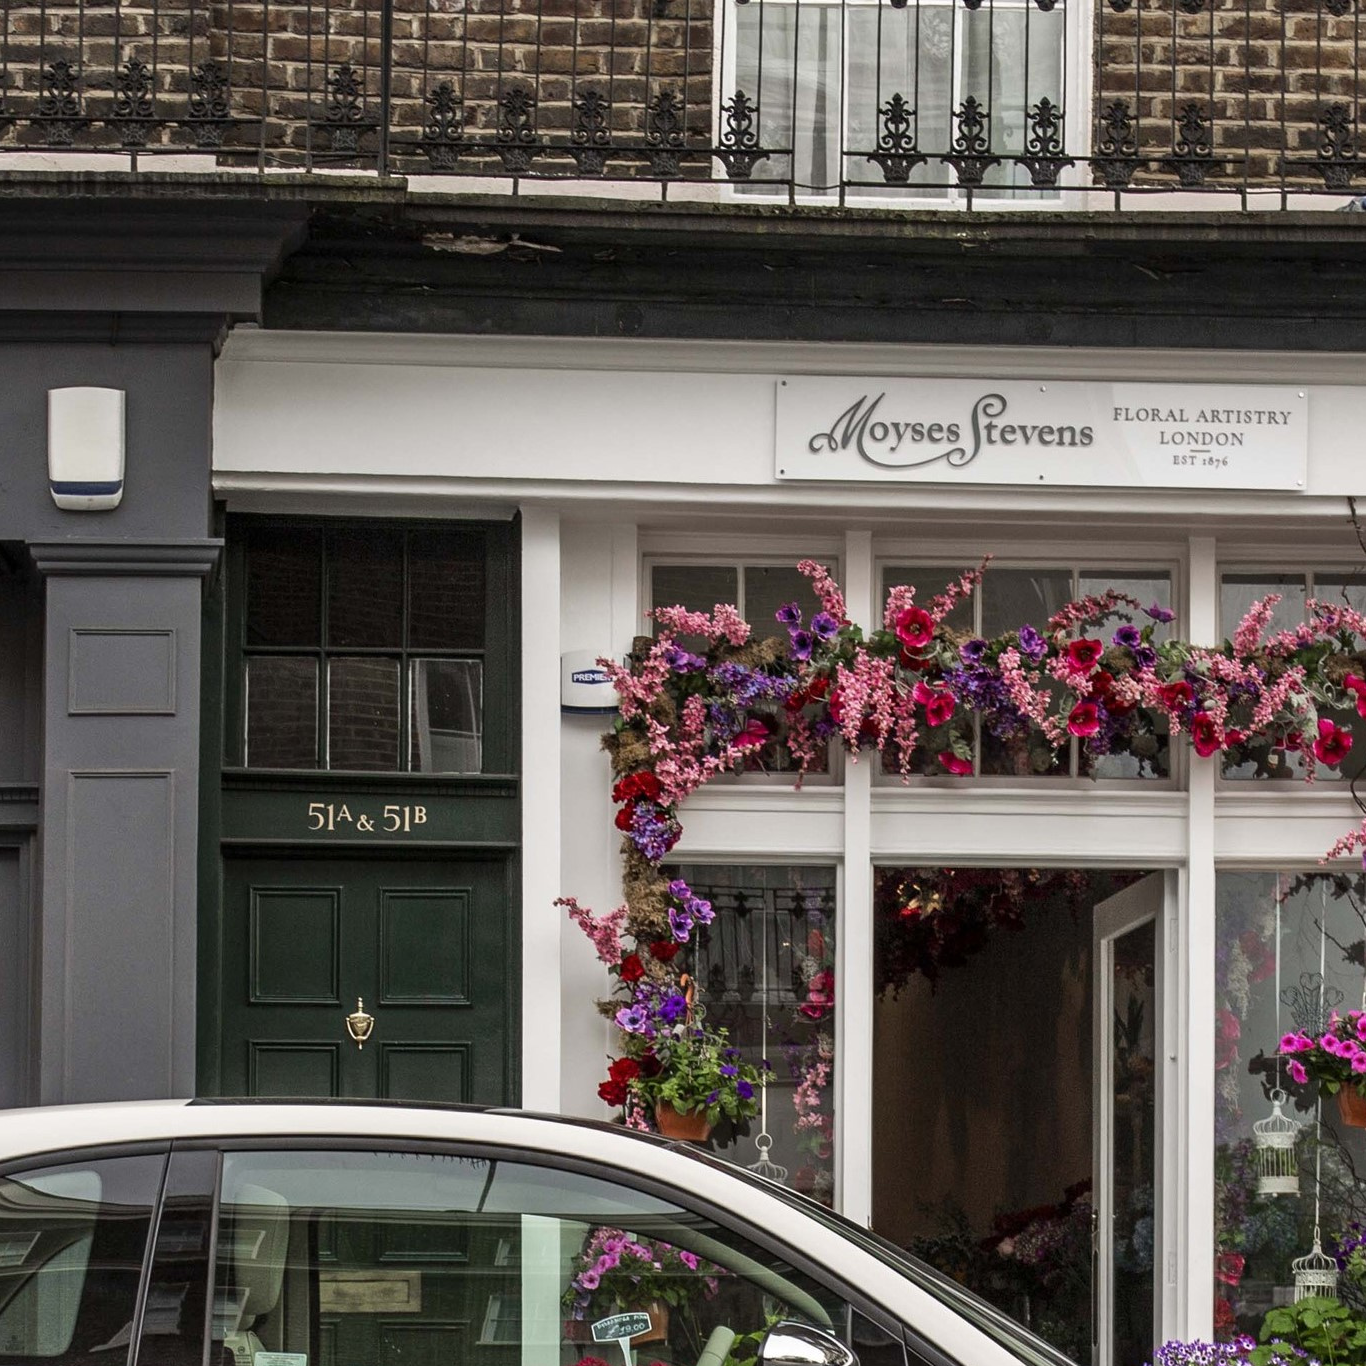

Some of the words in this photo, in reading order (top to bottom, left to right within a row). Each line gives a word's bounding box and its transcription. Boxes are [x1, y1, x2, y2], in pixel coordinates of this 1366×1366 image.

[1113, 407, 1189, 423] FLORAL
[1195, 409, 1292, 425] ARTISTRY
[808, 392, 963, 468] Moyses
[949, 393, 1094, 468] Stevens
[1159, 431, 1244, 446] LONDON
[1173, 455, 1197, 466] EST
[1202, 456, 1229, 469] 1876
[308, 803, 353, 831] 51A
[356, 814, 375, 832] &
[382, 805, 428, 832] 51B
